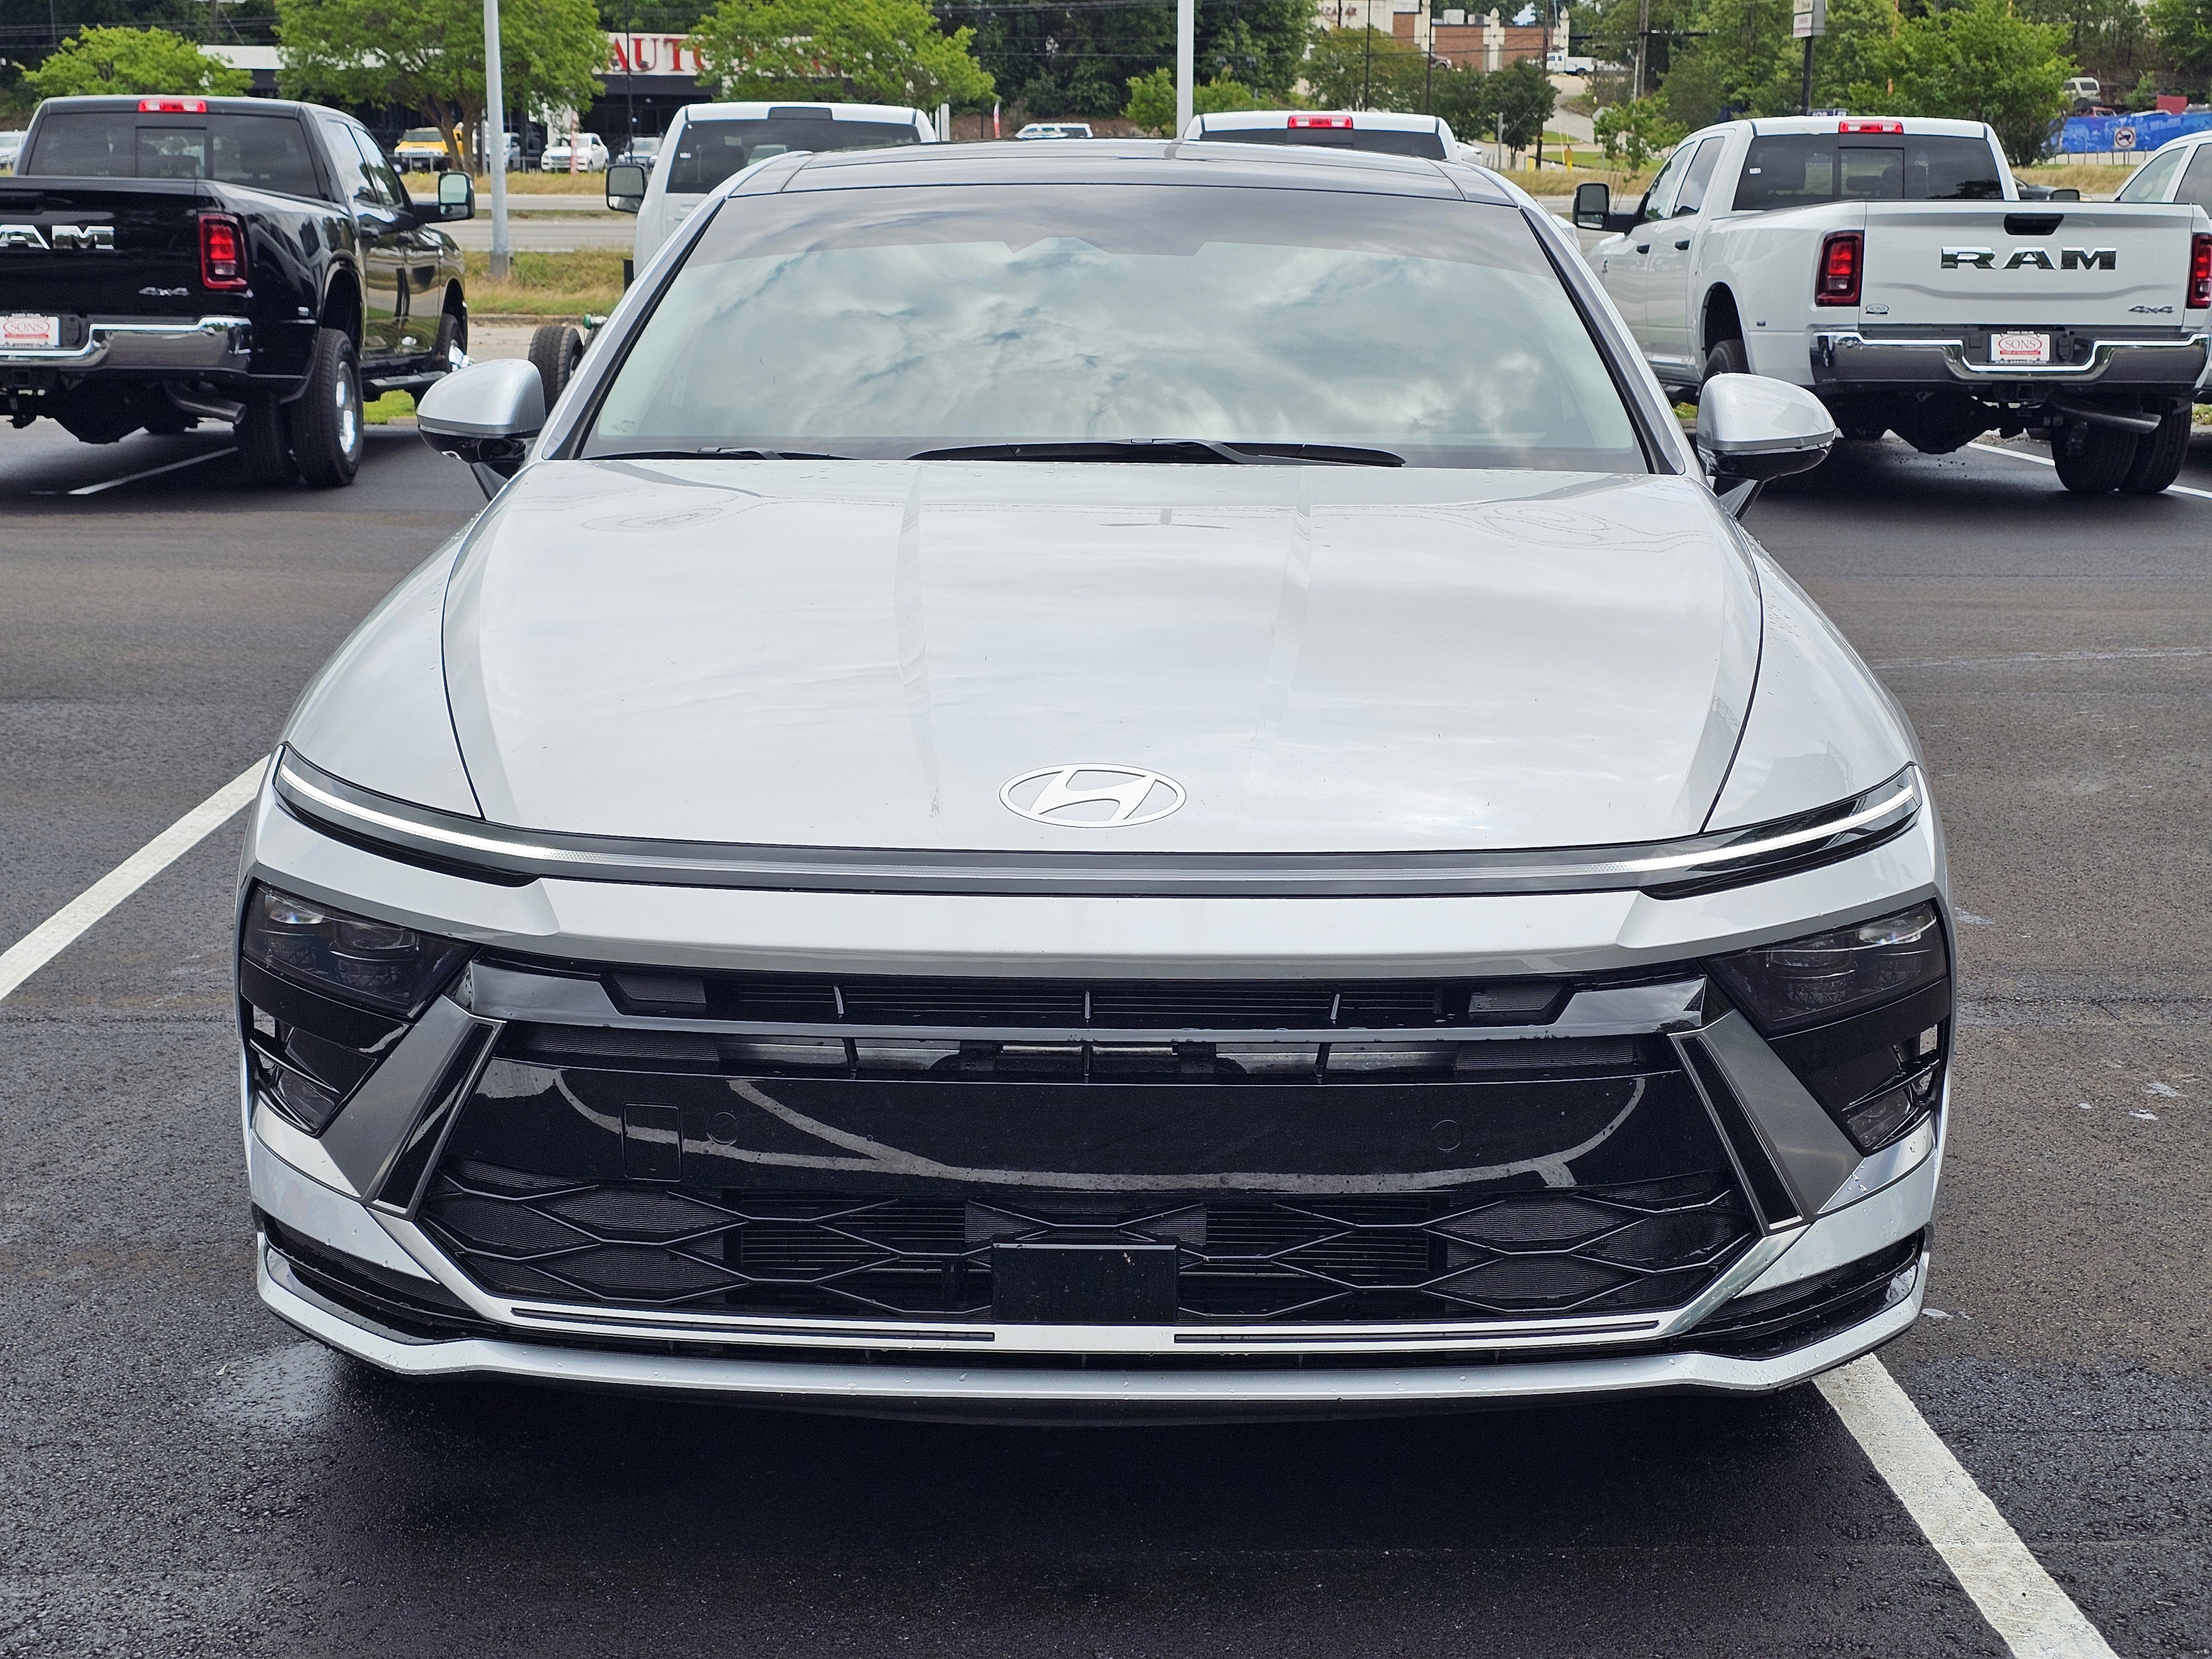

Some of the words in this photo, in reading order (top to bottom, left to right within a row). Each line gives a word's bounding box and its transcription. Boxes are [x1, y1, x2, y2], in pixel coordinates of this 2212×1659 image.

[1940, 247, 2117, 270] RAM
[138, 286, 190, 296] 4x4
[2127, 305, 2174, 314] 4x4
[10, 322, 44, 332] SONS
[2005, 339, 2036, 349] SONS
